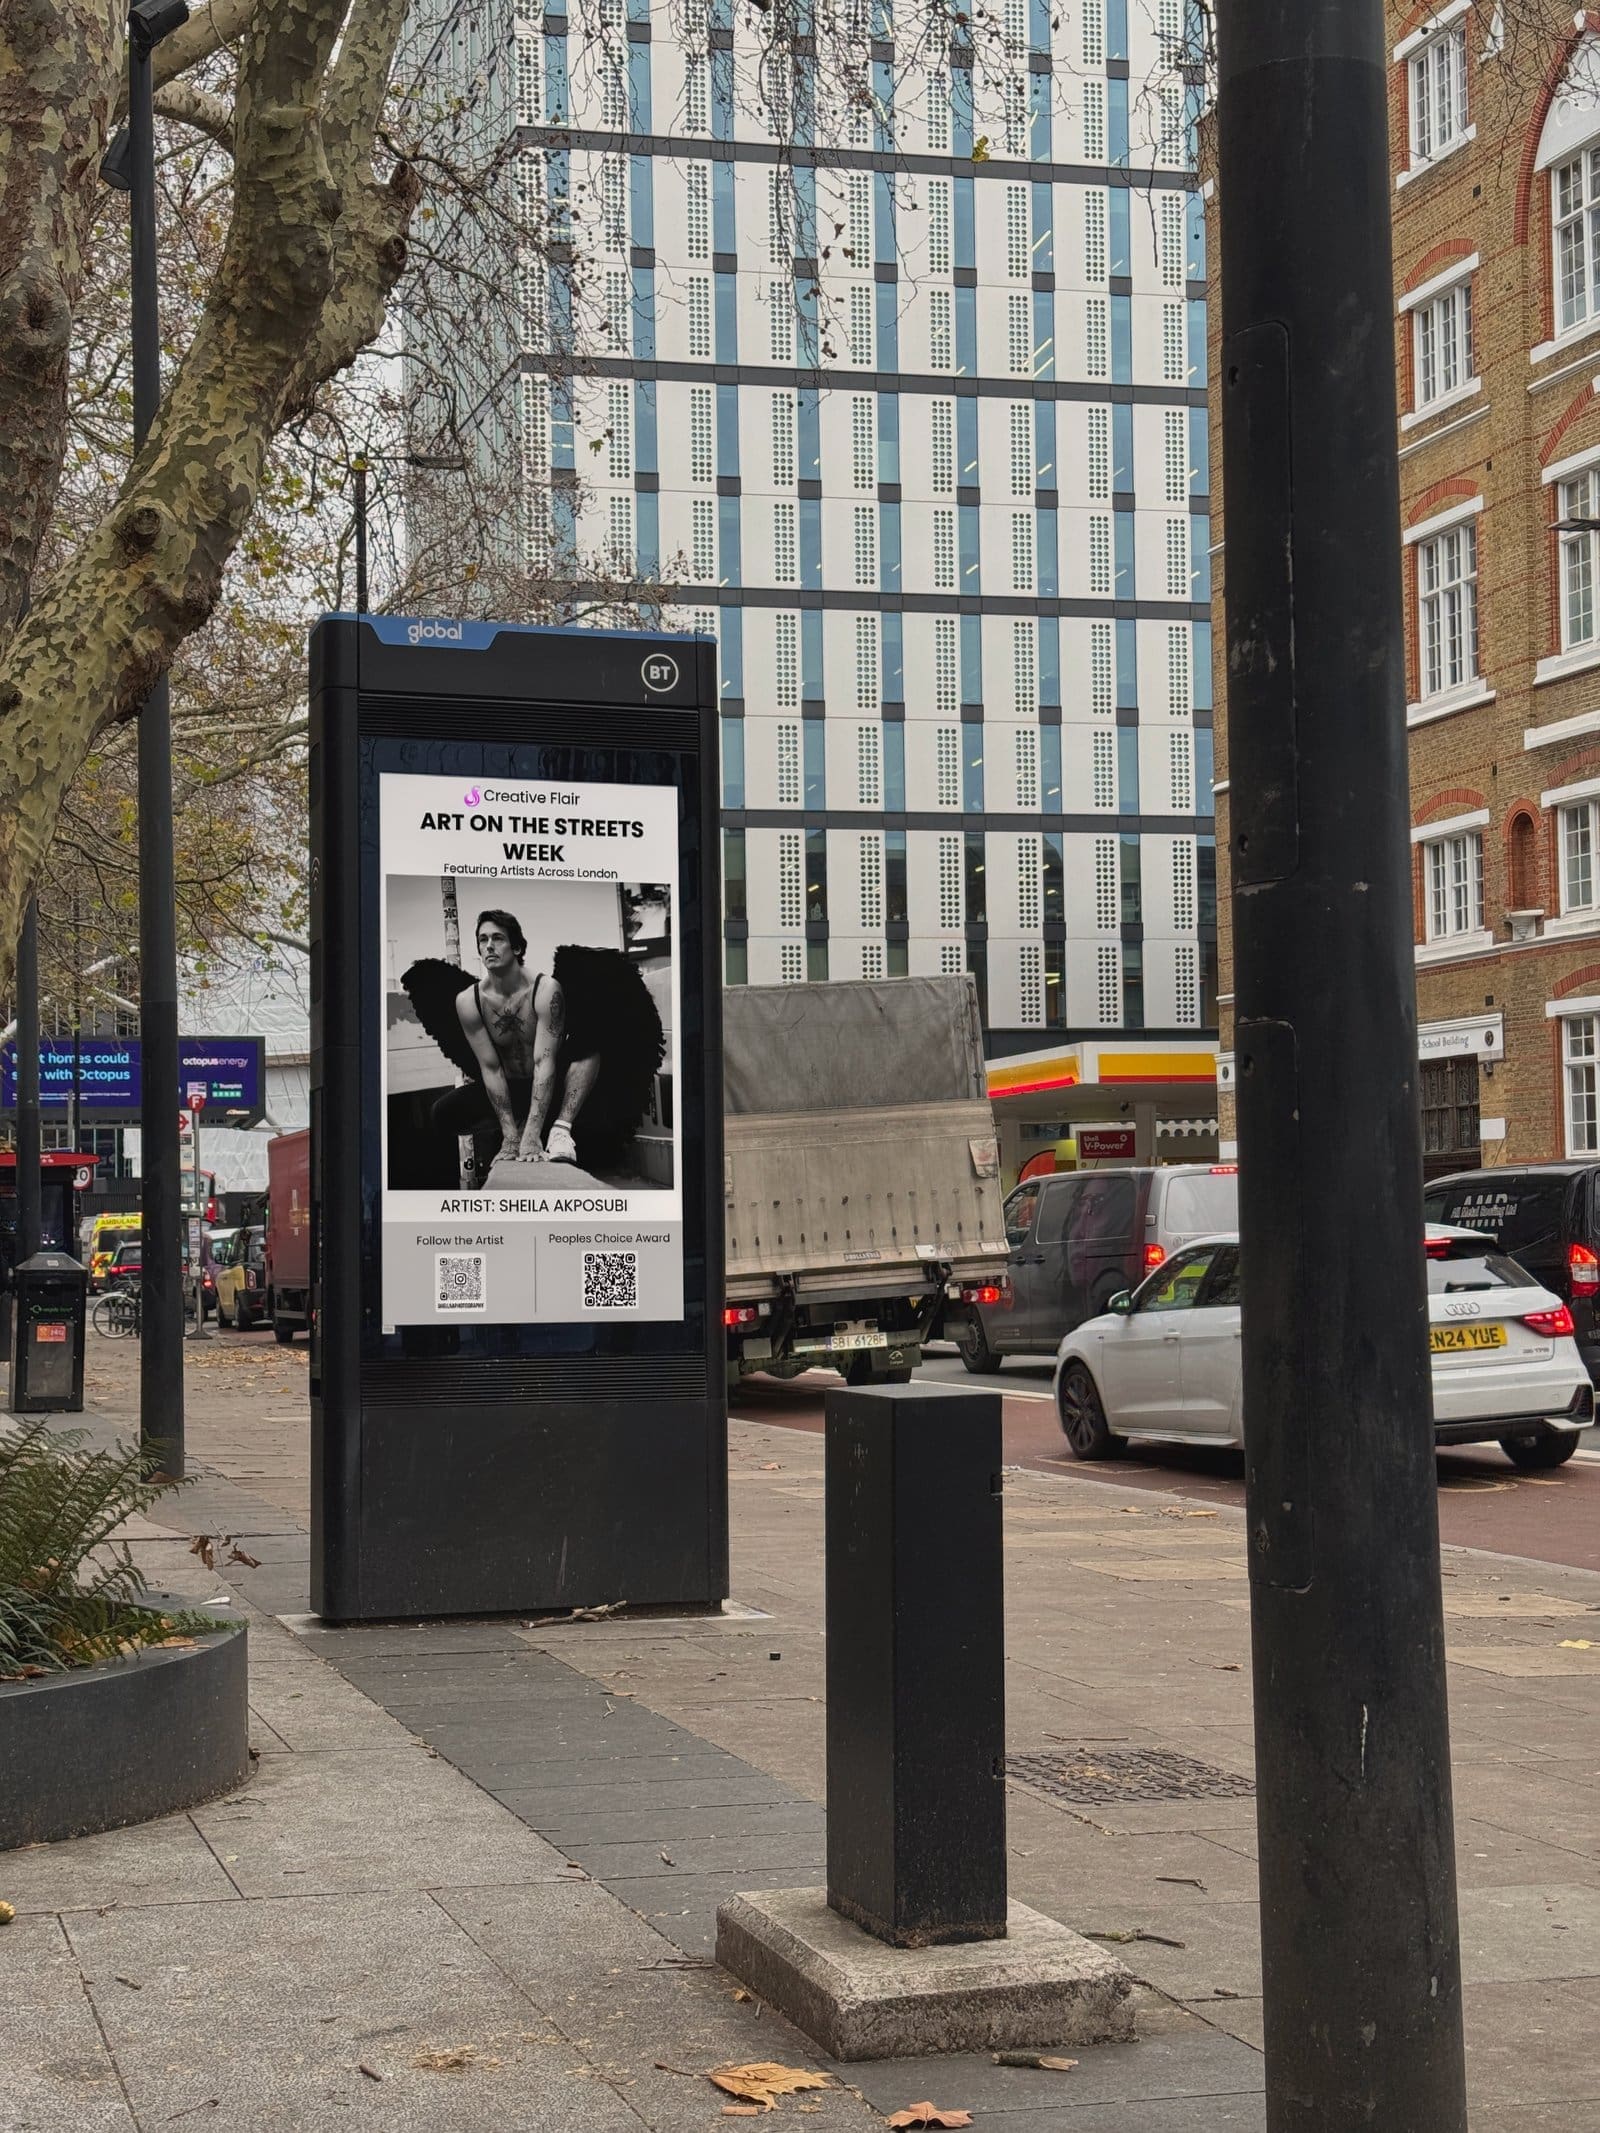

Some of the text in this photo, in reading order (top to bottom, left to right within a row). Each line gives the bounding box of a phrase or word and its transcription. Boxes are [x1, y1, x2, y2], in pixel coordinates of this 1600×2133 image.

[407, 620, 463, 644] global
[649, 664, 671, 680] BT
[483, 789, 580, 806] Creative Flair
[420, 812, 644, 838] ART ON THE STREETS
[503, 843, 565, 862] WEEK
[443, 862, 618, 880] Featuring Artists Across London
[1422, 1038, 1441, 1049] School
[94, 1053, 130, 1065] could
[44, 1069, 73, 1081] with
[78, 1069, 131, 1082] Octopus
[191, 1095, 200, 1109] F
[440, 1198, 628, 1213] ARTIST: SHEILA AKPOSUBI
[416, 1234, 504, 1246] Follow the Artist
[548, 1232, 671, 1246] Peoples Choice Award
[1469, 1327, 1500, 1346] YUE
